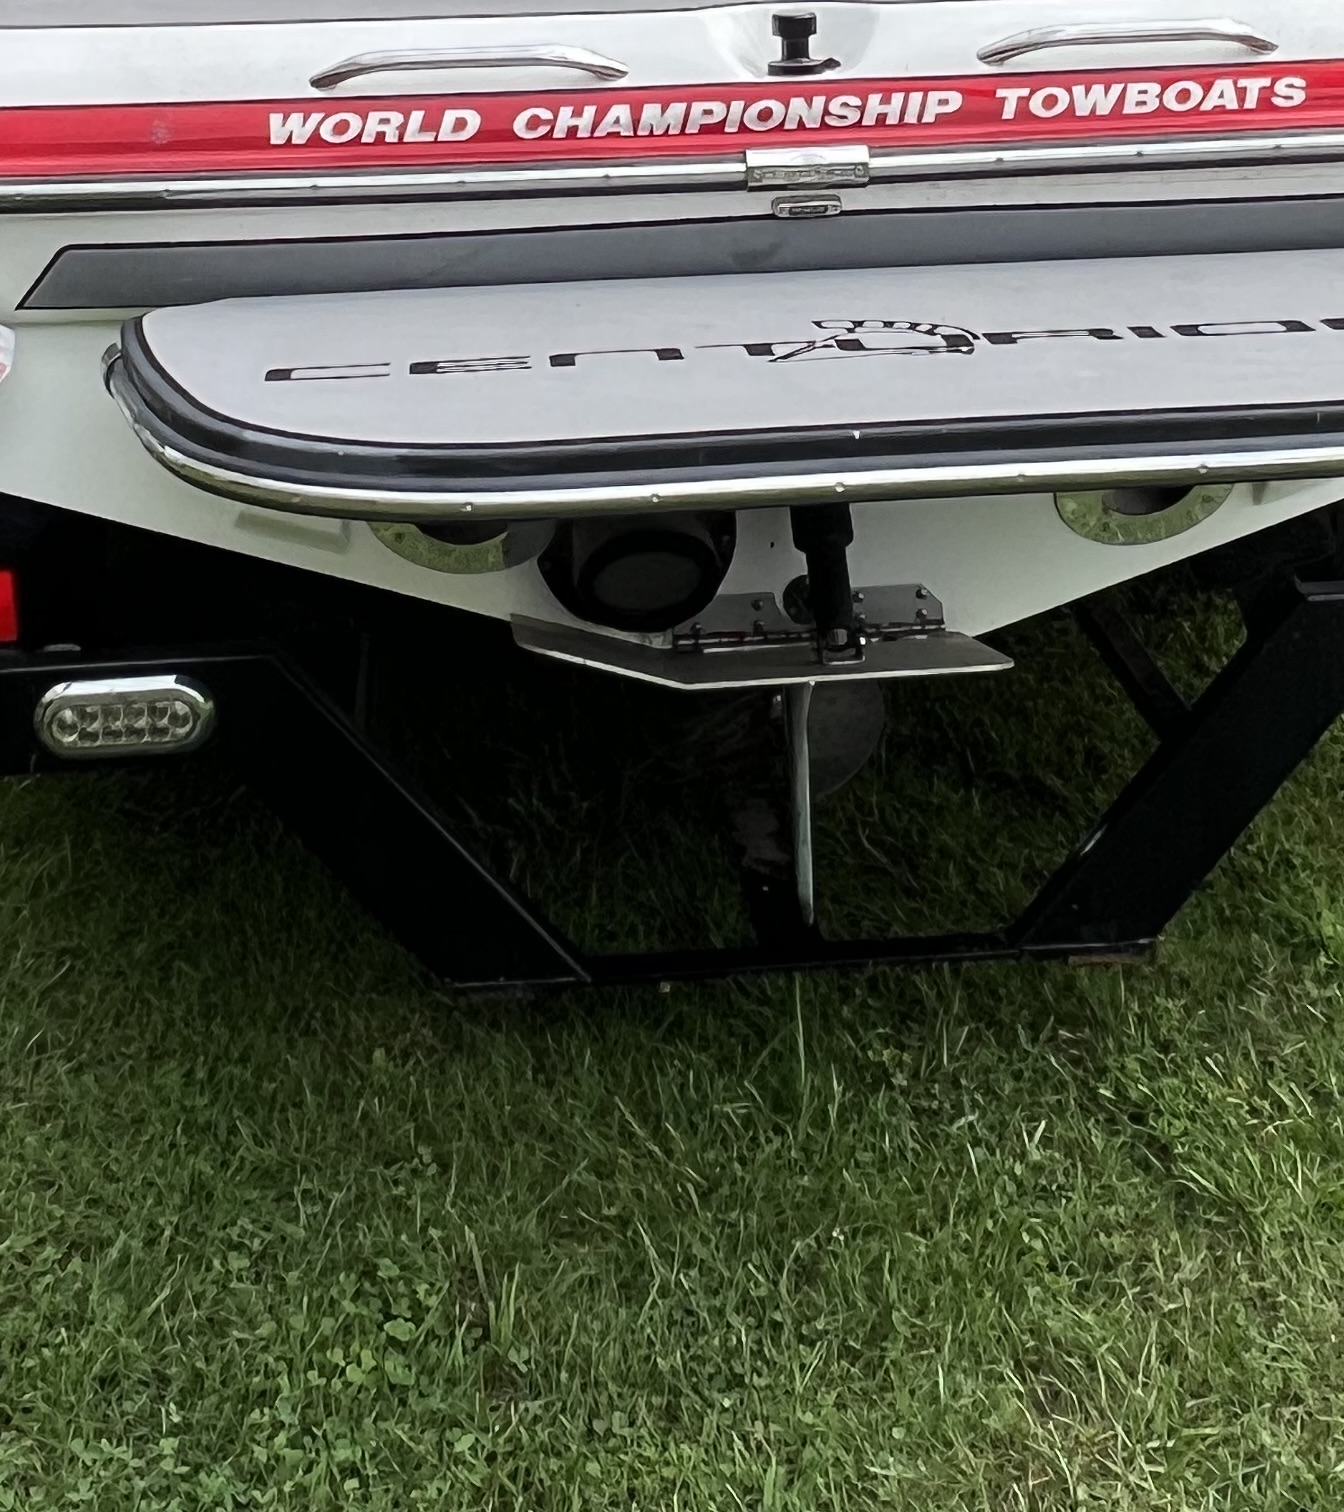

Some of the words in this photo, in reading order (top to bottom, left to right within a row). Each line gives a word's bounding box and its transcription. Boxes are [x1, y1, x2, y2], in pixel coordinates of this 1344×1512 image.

[268, 109, 482, 145] WORLD
[512, 90, 963, 140] CHAMPIONSHIP
[995, 76, 1307, 120] TOWBOATS
